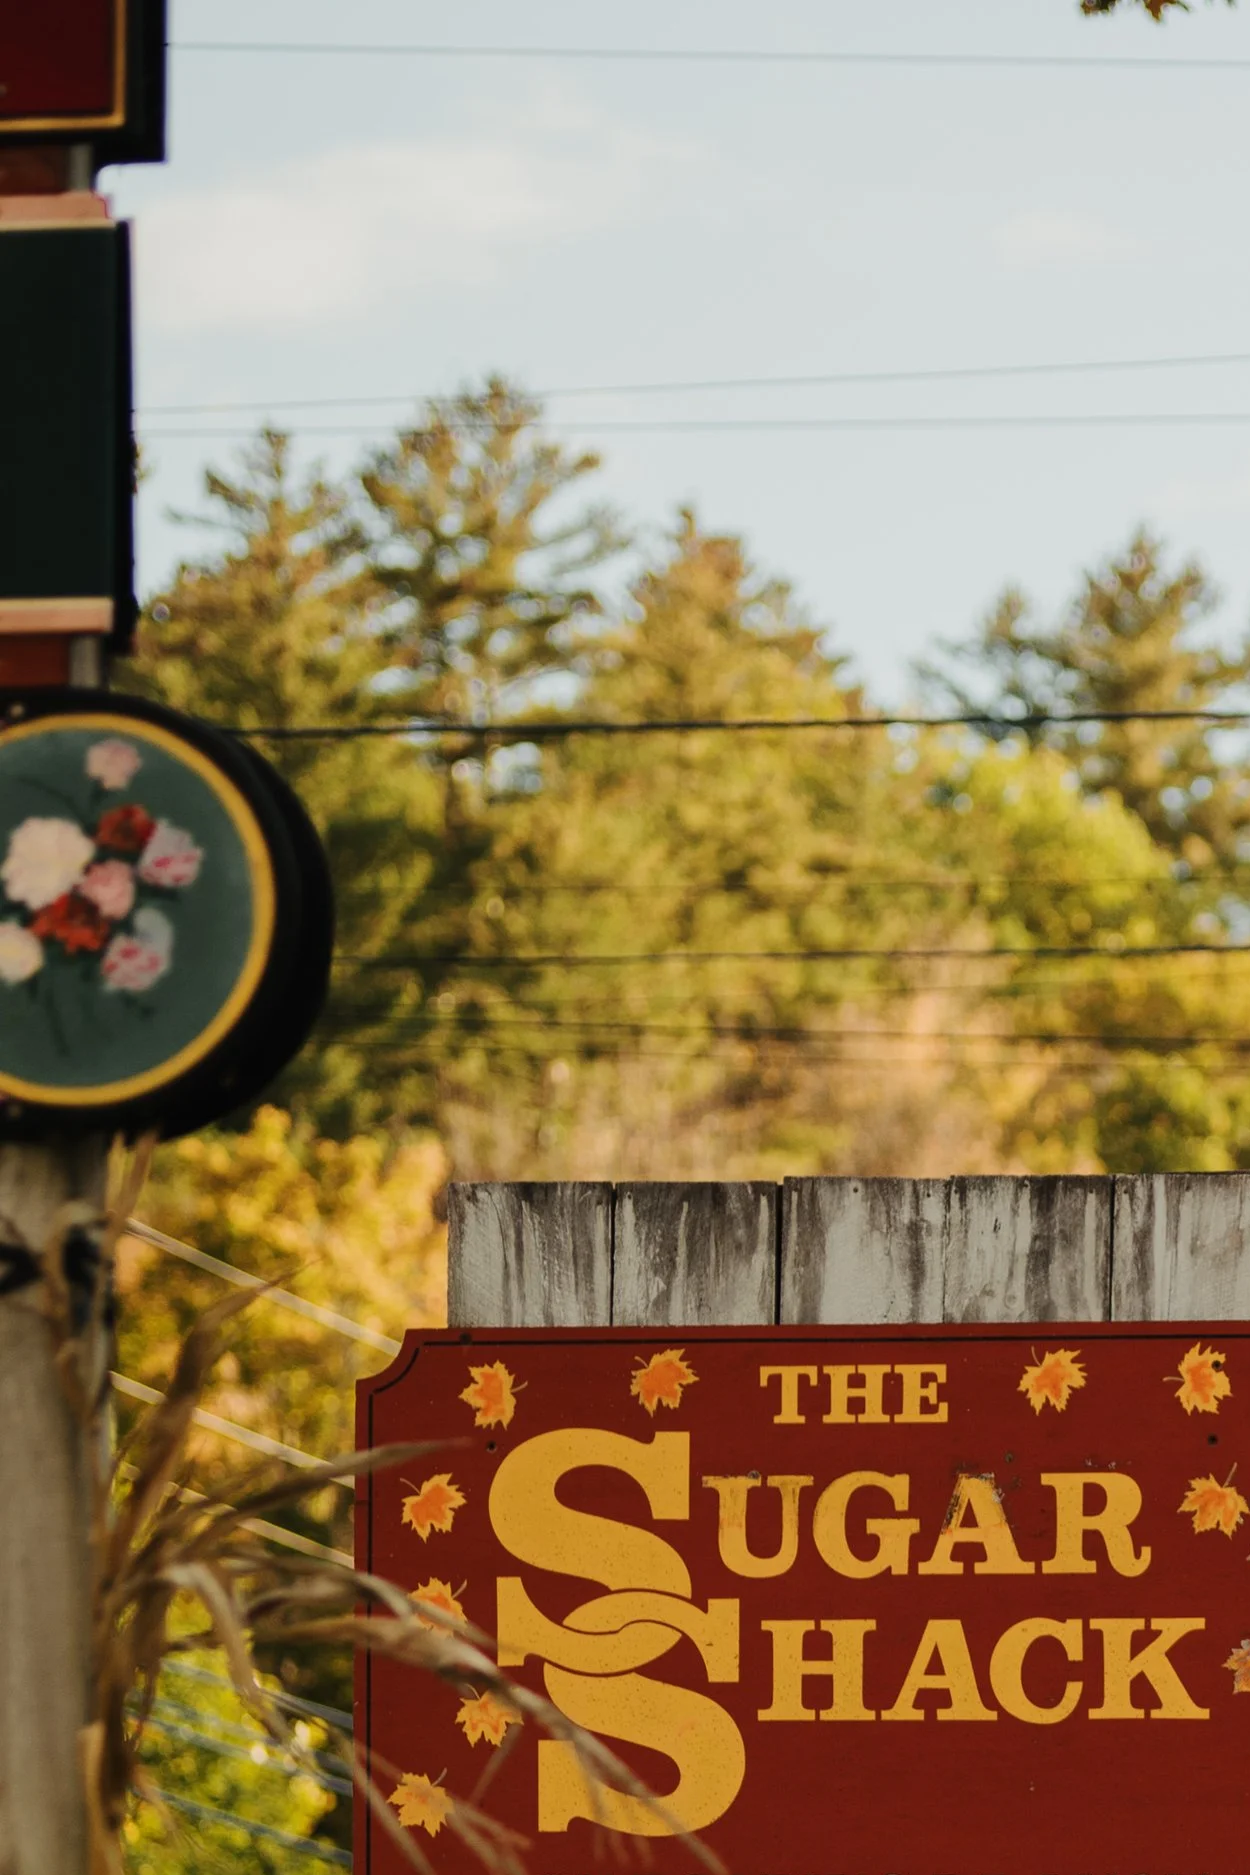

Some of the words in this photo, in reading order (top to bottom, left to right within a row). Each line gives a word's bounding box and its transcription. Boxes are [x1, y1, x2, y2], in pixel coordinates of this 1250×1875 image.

[759, 1363, 949, 1424] THE
[488, 1427, 1152, 1675] SUGAR
[537, 1590, 1210, 1837] SHACK
